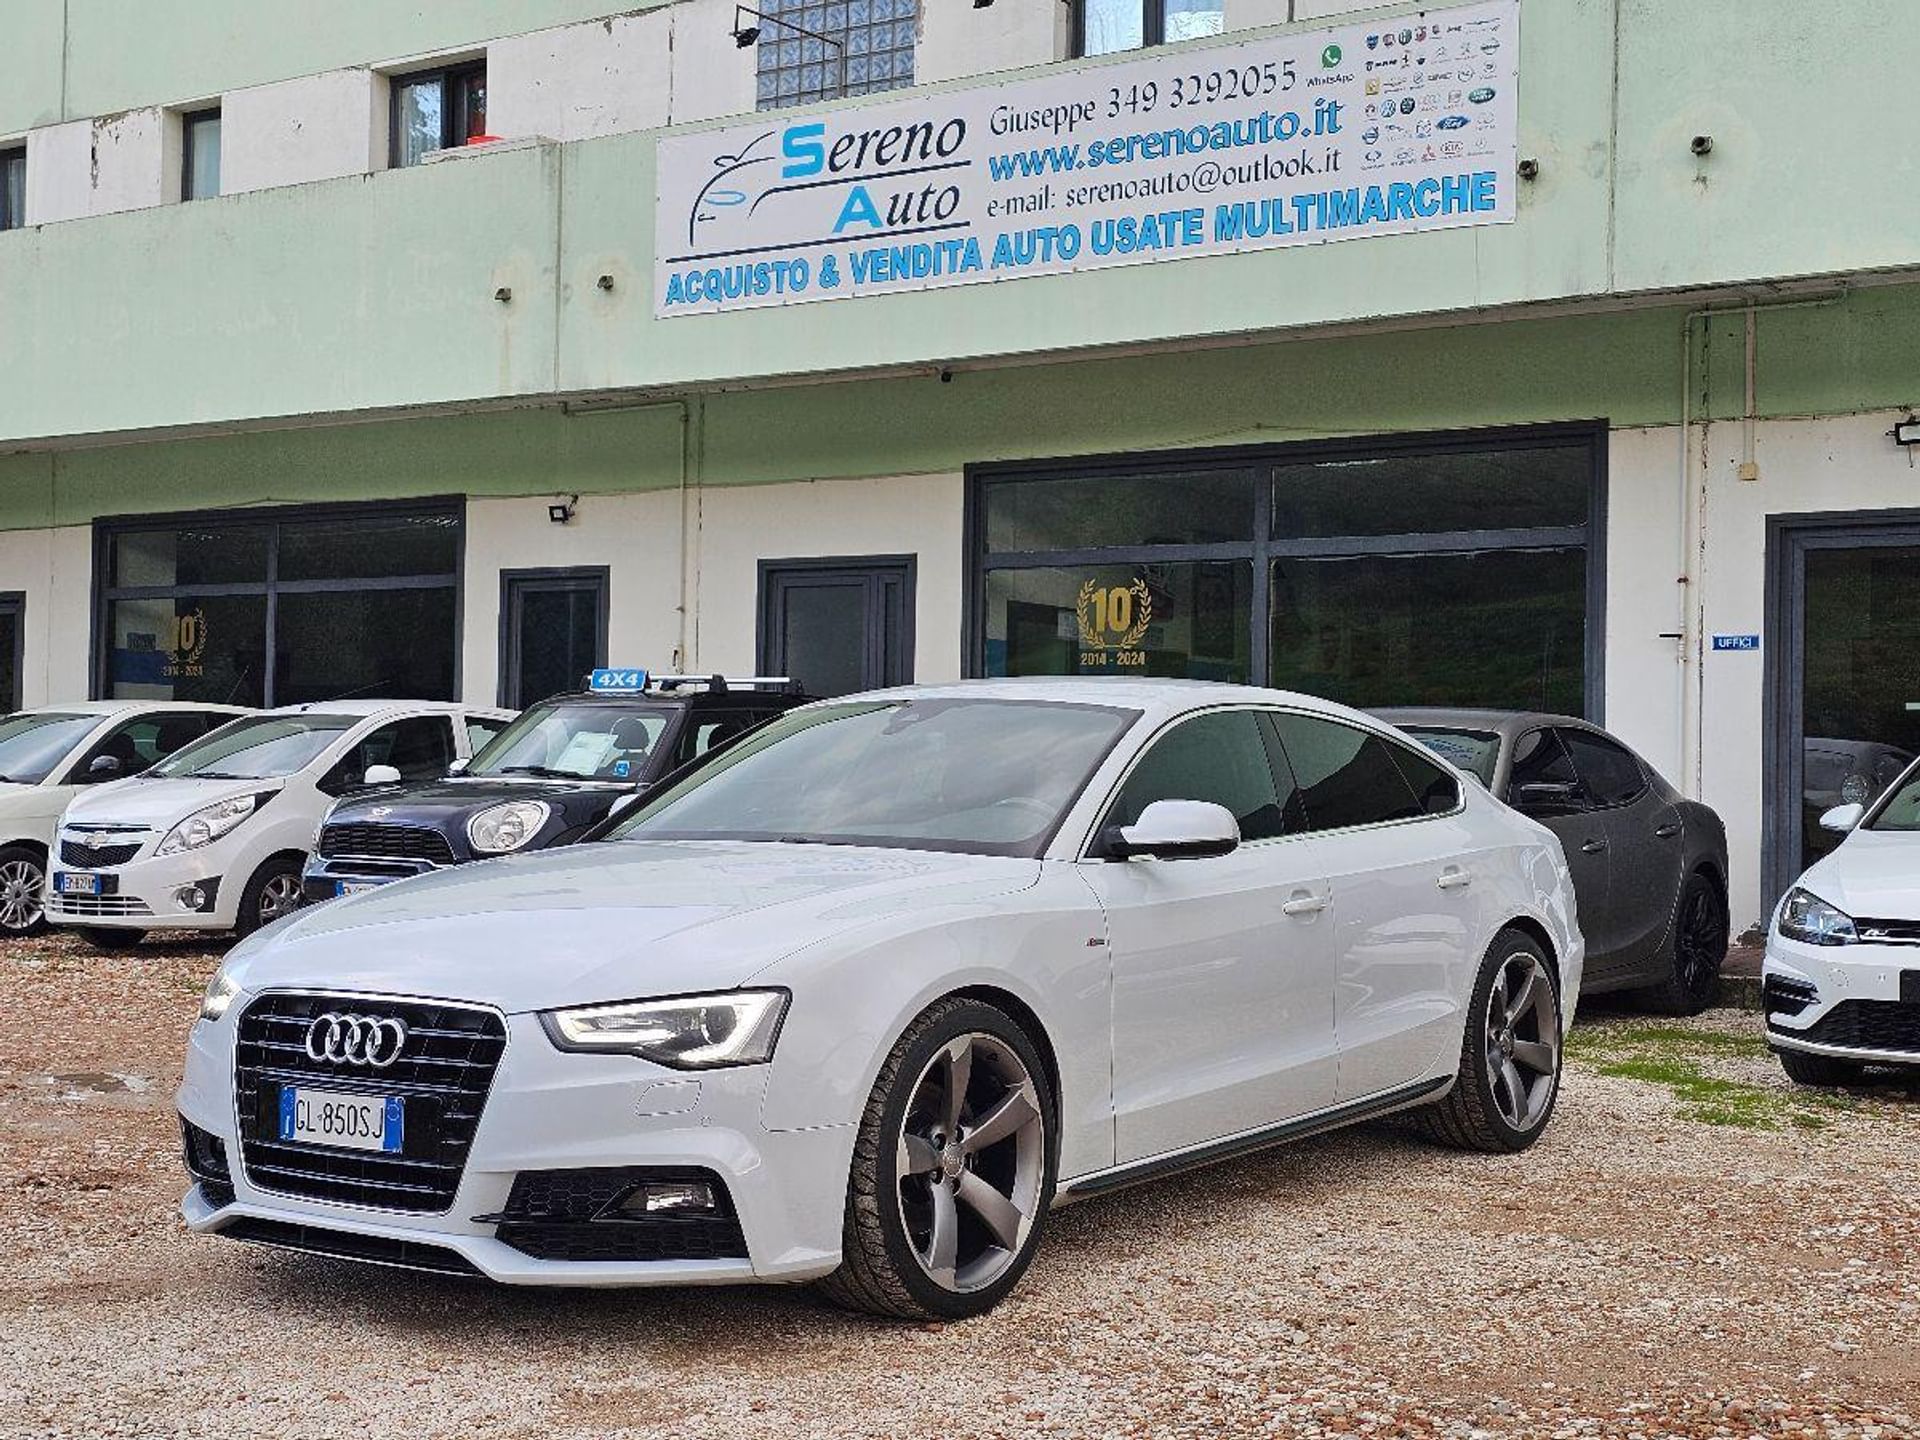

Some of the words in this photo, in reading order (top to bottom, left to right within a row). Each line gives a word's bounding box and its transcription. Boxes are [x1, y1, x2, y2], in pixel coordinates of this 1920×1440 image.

[990, 98, 1096, 135] Giuseppe
[1107, 82, 1158, 118] 349
[1168, 60, 1298, 108] 3292055
[782, 118, 966, 179] Sereno
[989, 98, 1344, 182] www.serenoauto.it
[832, 183, 960, 233] Auto
[987, 184, 1056, 218] e-mail:
[1066, 147, 1342, 209] serenoauto@outlook.it
[665, 258, 810, 306] ACQUISTO
[819, 254, 840, 289] &
[850, 237, 983, 284] VENDITA
[991, 223, 1081, 270] AUTO
[1091, 207, 1204, 255] USATE
[1215, 171, 1497, 242] MULTIMARCHE
[1080, 652, 1107, 665] 2014
[1117, 651, 1146, 665] 2024
[1718, 637, 1752, 648] UFFICI
